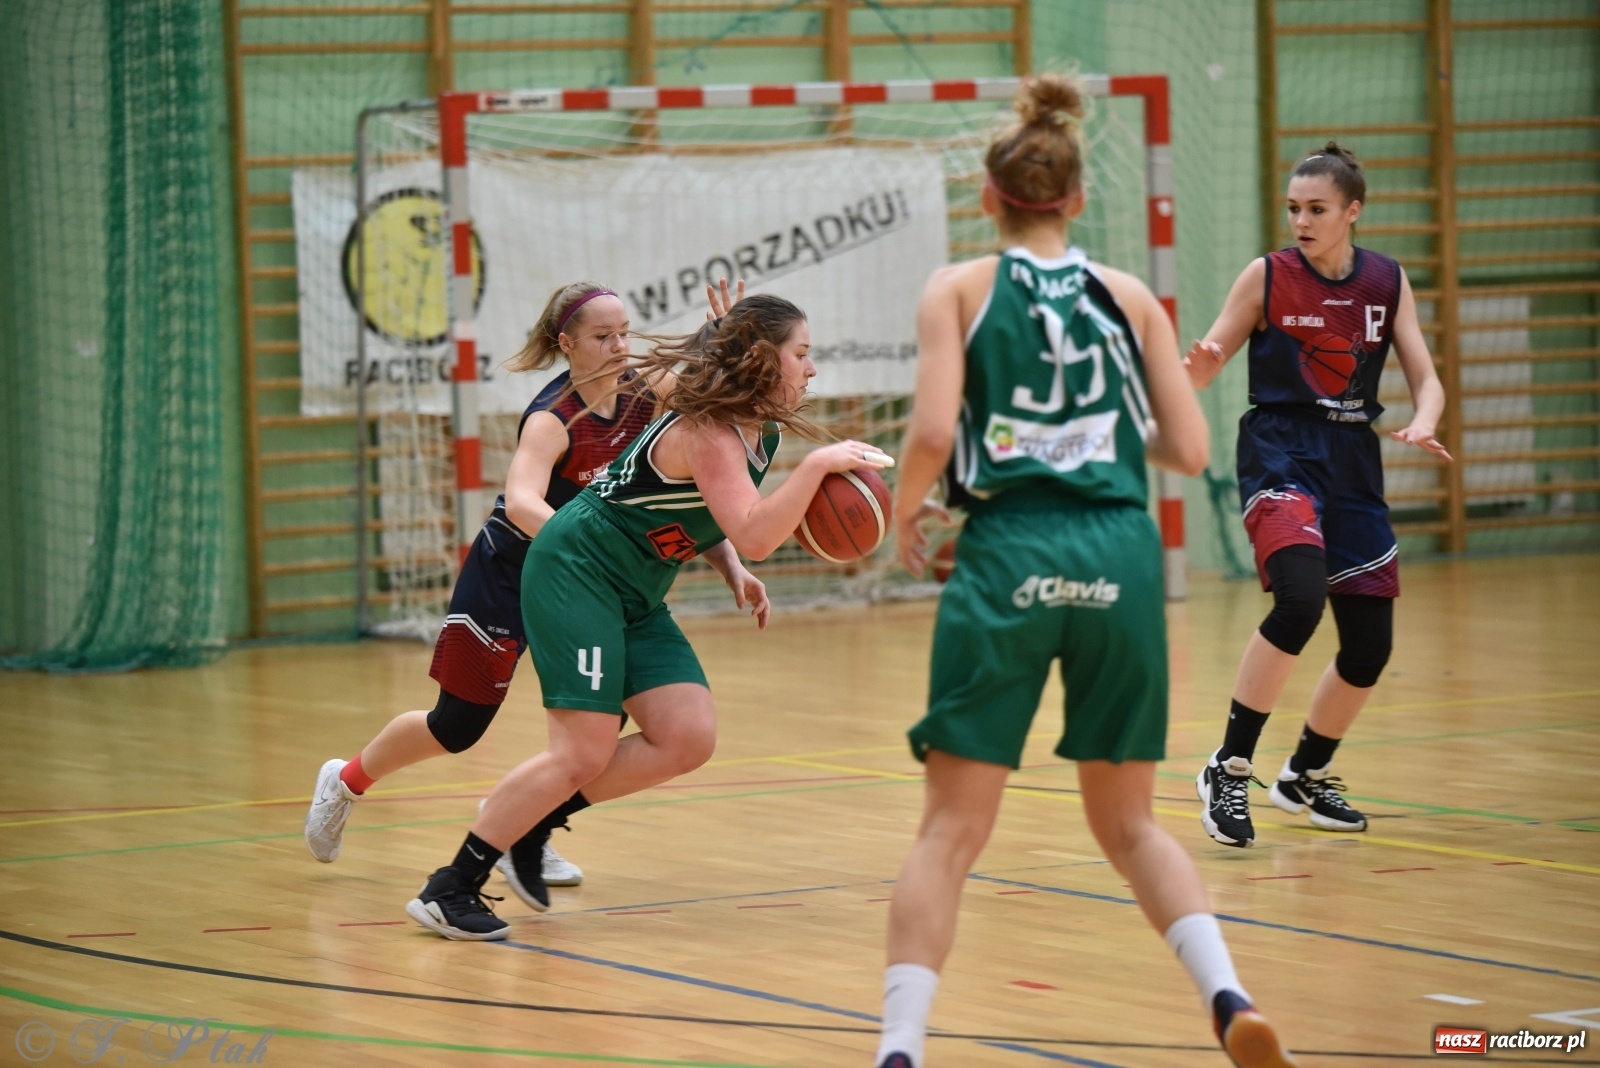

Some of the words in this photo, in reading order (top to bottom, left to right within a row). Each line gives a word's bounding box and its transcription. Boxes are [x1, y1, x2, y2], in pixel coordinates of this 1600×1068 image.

[628, 277, 670, 322] W
[676, 189, 910, 303] PORZĄDKU!
[1364, 304, 1388, 343] 12
[578, 470, 592, 482] UKS
[1038, 575, 1121, 603] Clavis
[577, 646, 604, 692] 4
